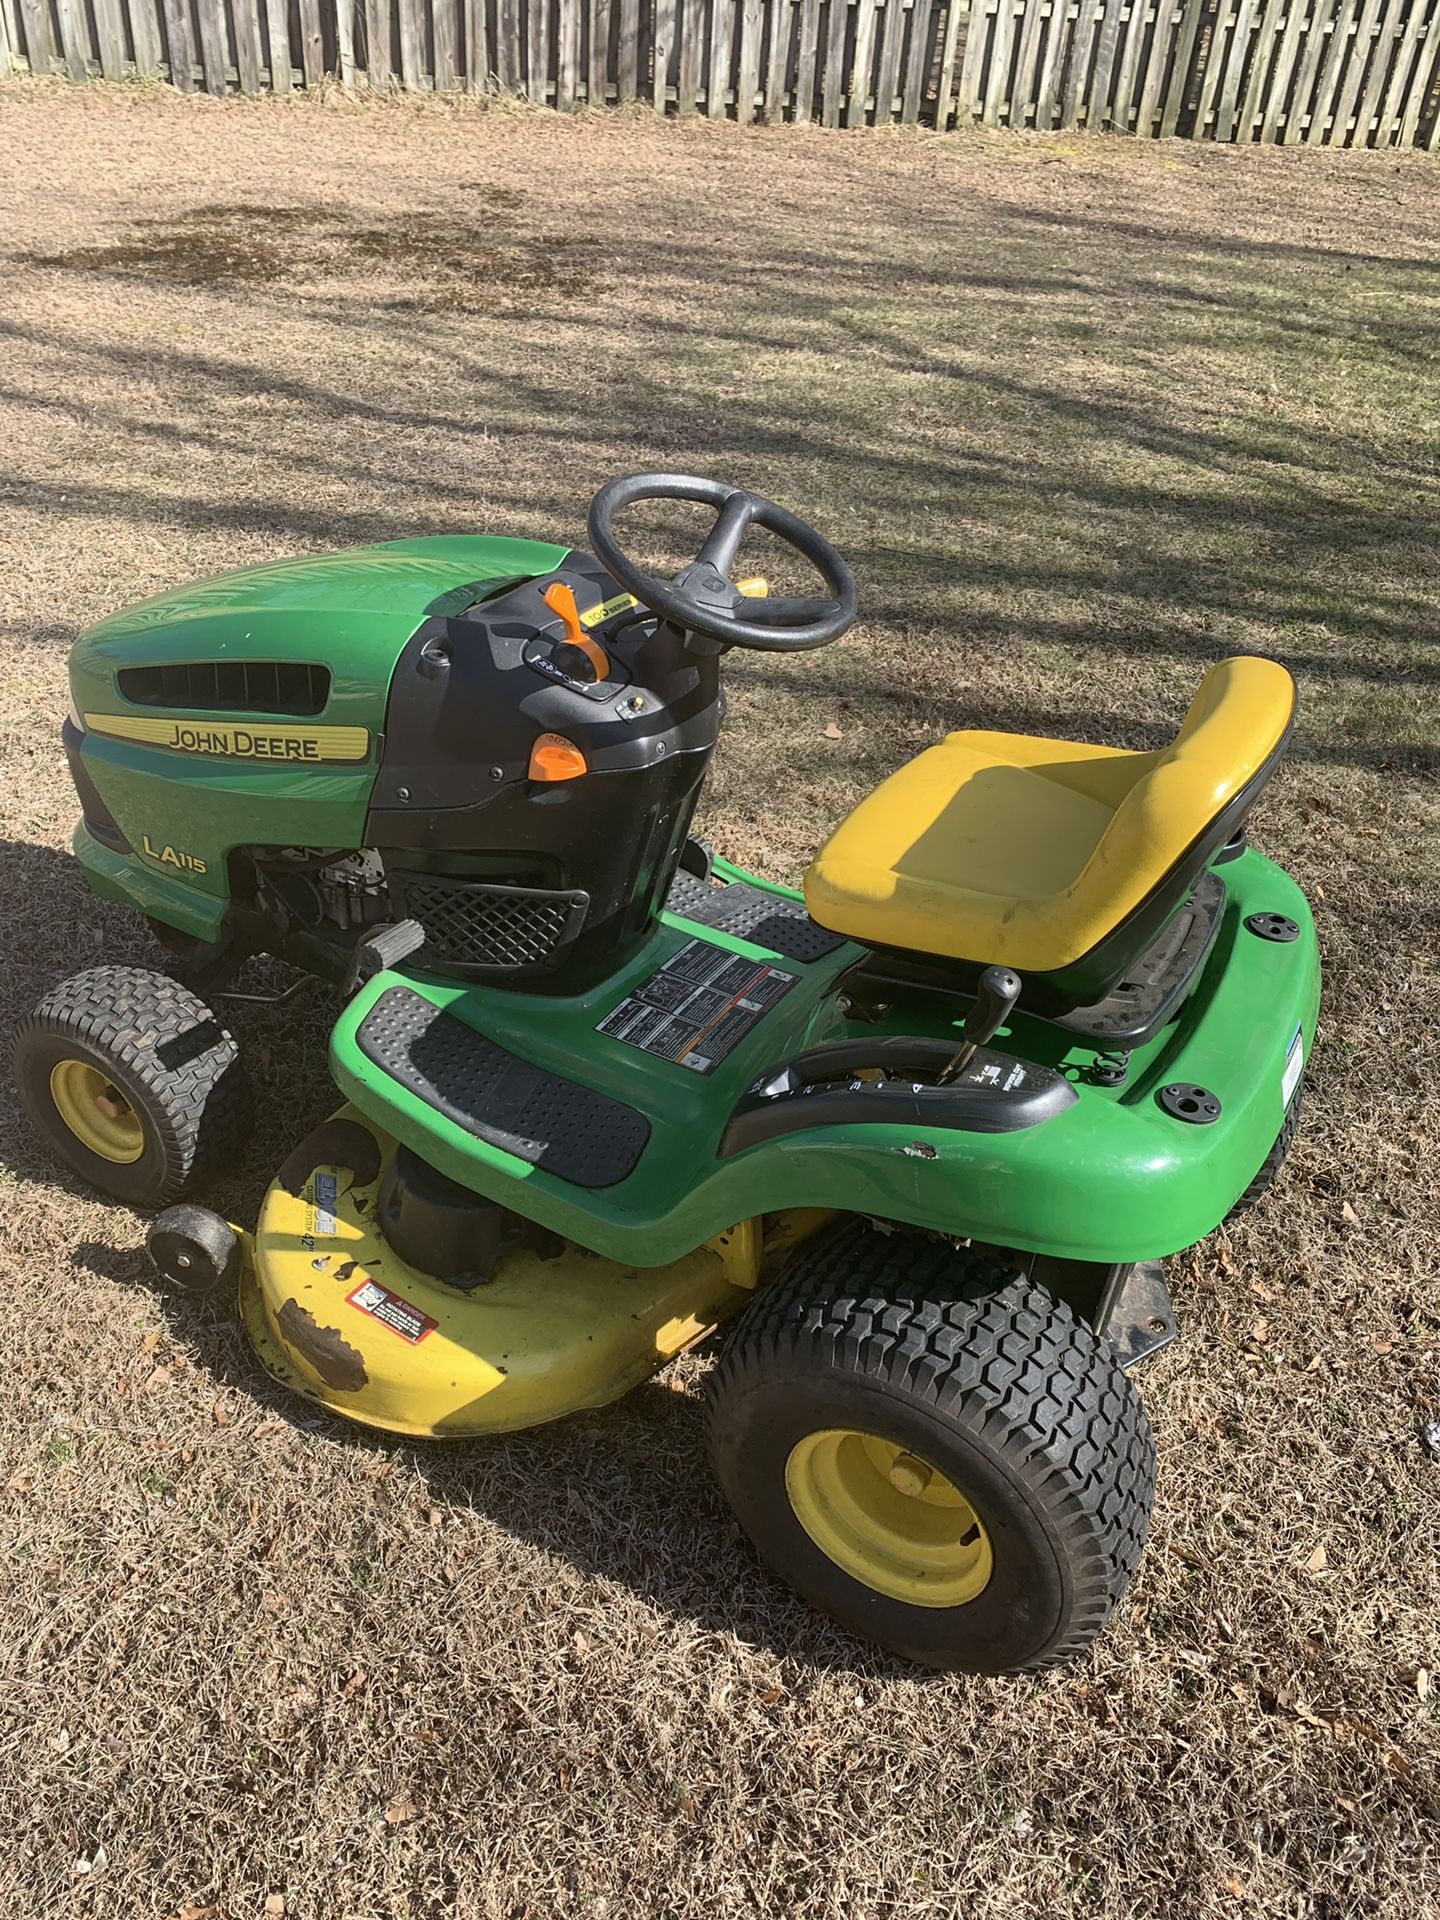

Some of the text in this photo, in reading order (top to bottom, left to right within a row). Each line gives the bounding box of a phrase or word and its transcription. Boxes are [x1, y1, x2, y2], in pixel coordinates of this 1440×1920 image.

[588, 599, 632, 622] 100 SERIES
[169, 725, 320, 759] JOHN DEERE
[142, 834, 207, 874] LA115
[315, 1172, 337, 1235] EDGE
[305, 1210, 313, 1232] SYSTEM
[301, 1232, 315, 1252] 42"
[402, 1303, 426, 1320] DANGER
